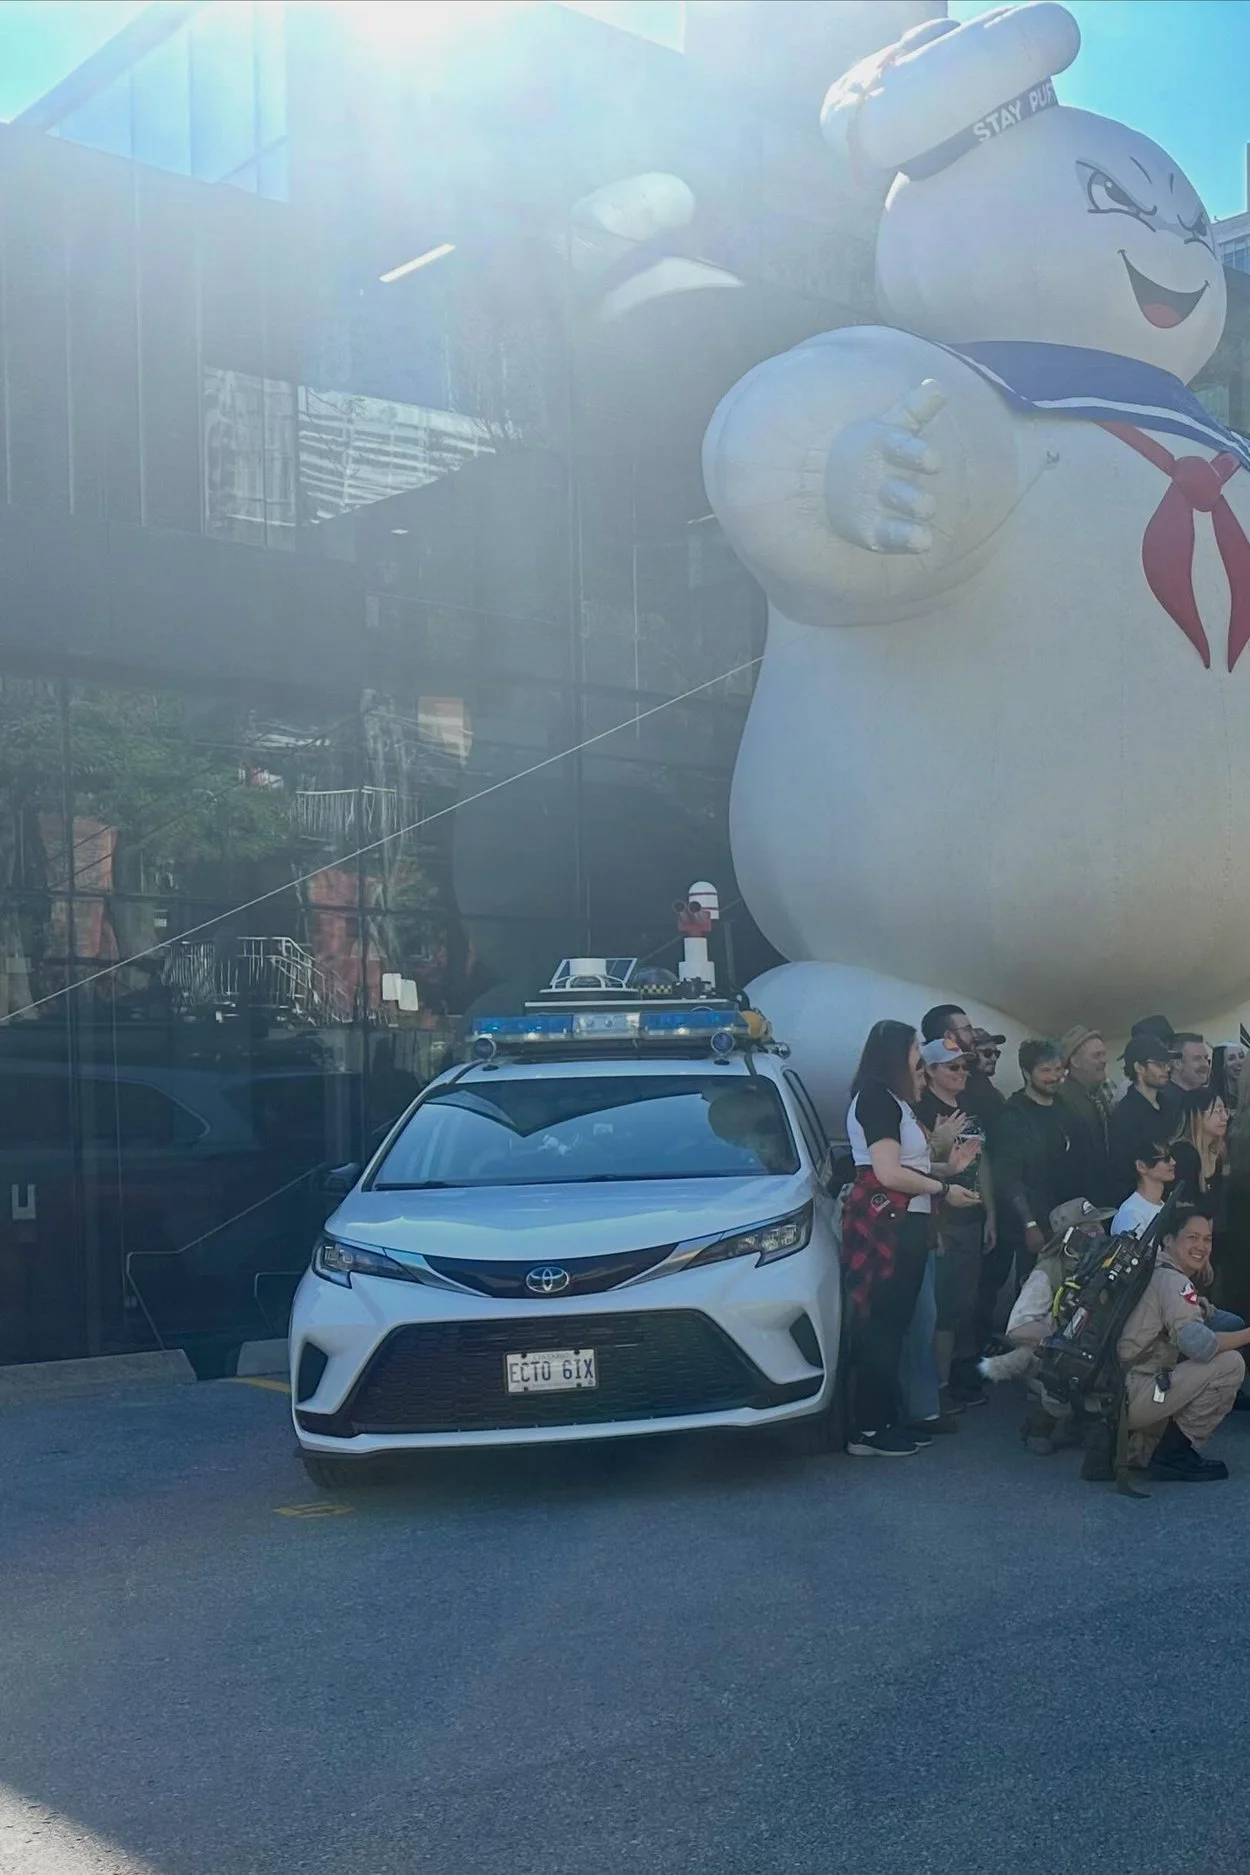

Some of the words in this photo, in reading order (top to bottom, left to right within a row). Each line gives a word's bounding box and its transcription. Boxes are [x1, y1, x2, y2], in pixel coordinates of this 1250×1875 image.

[973, 100, 1021, 141] STAY
[509, 1361, 551, 1383] ECTO
[562, 1358, 594, 1380] 6IX
